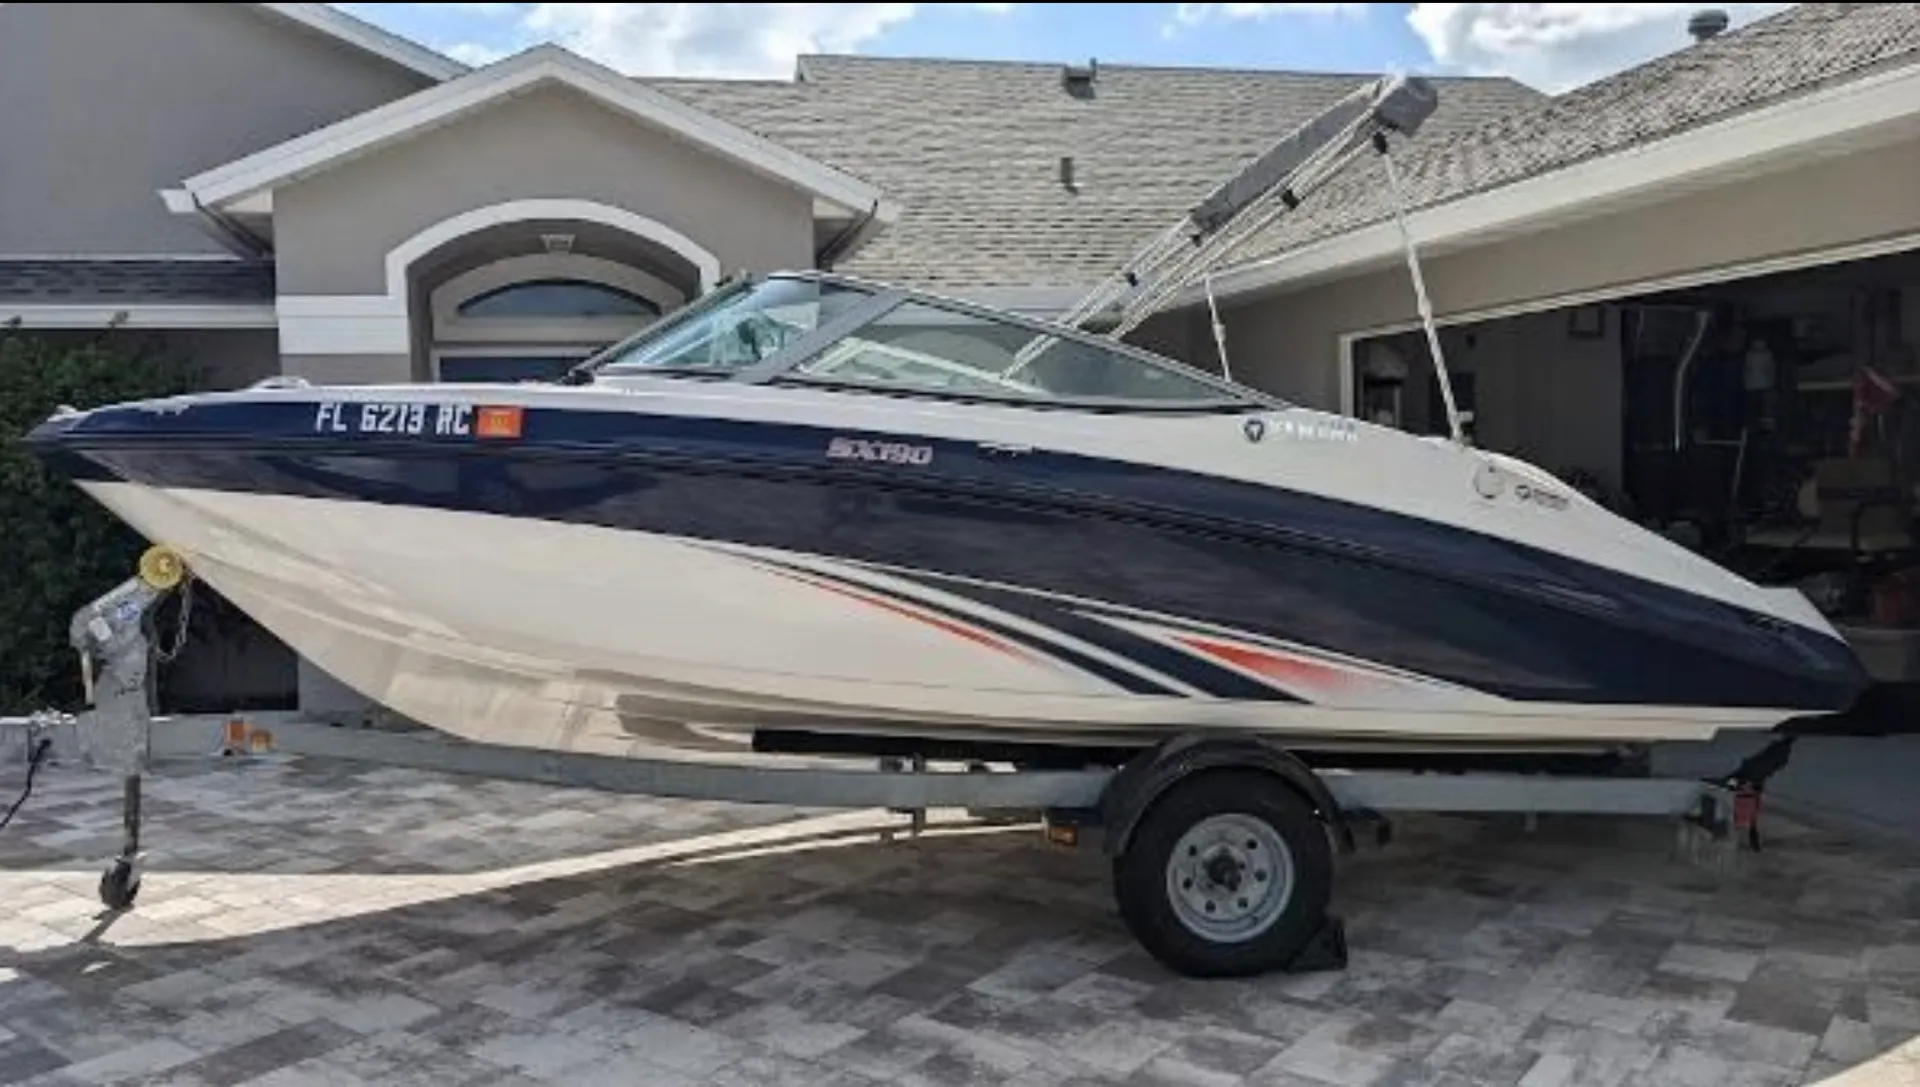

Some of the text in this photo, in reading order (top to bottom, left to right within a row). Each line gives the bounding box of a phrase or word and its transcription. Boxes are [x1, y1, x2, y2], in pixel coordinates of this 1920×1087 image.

[316, 402, 347, 431] FL
[360, 403, 424, 434] 6213
[436, 404, 472, 435] RC
